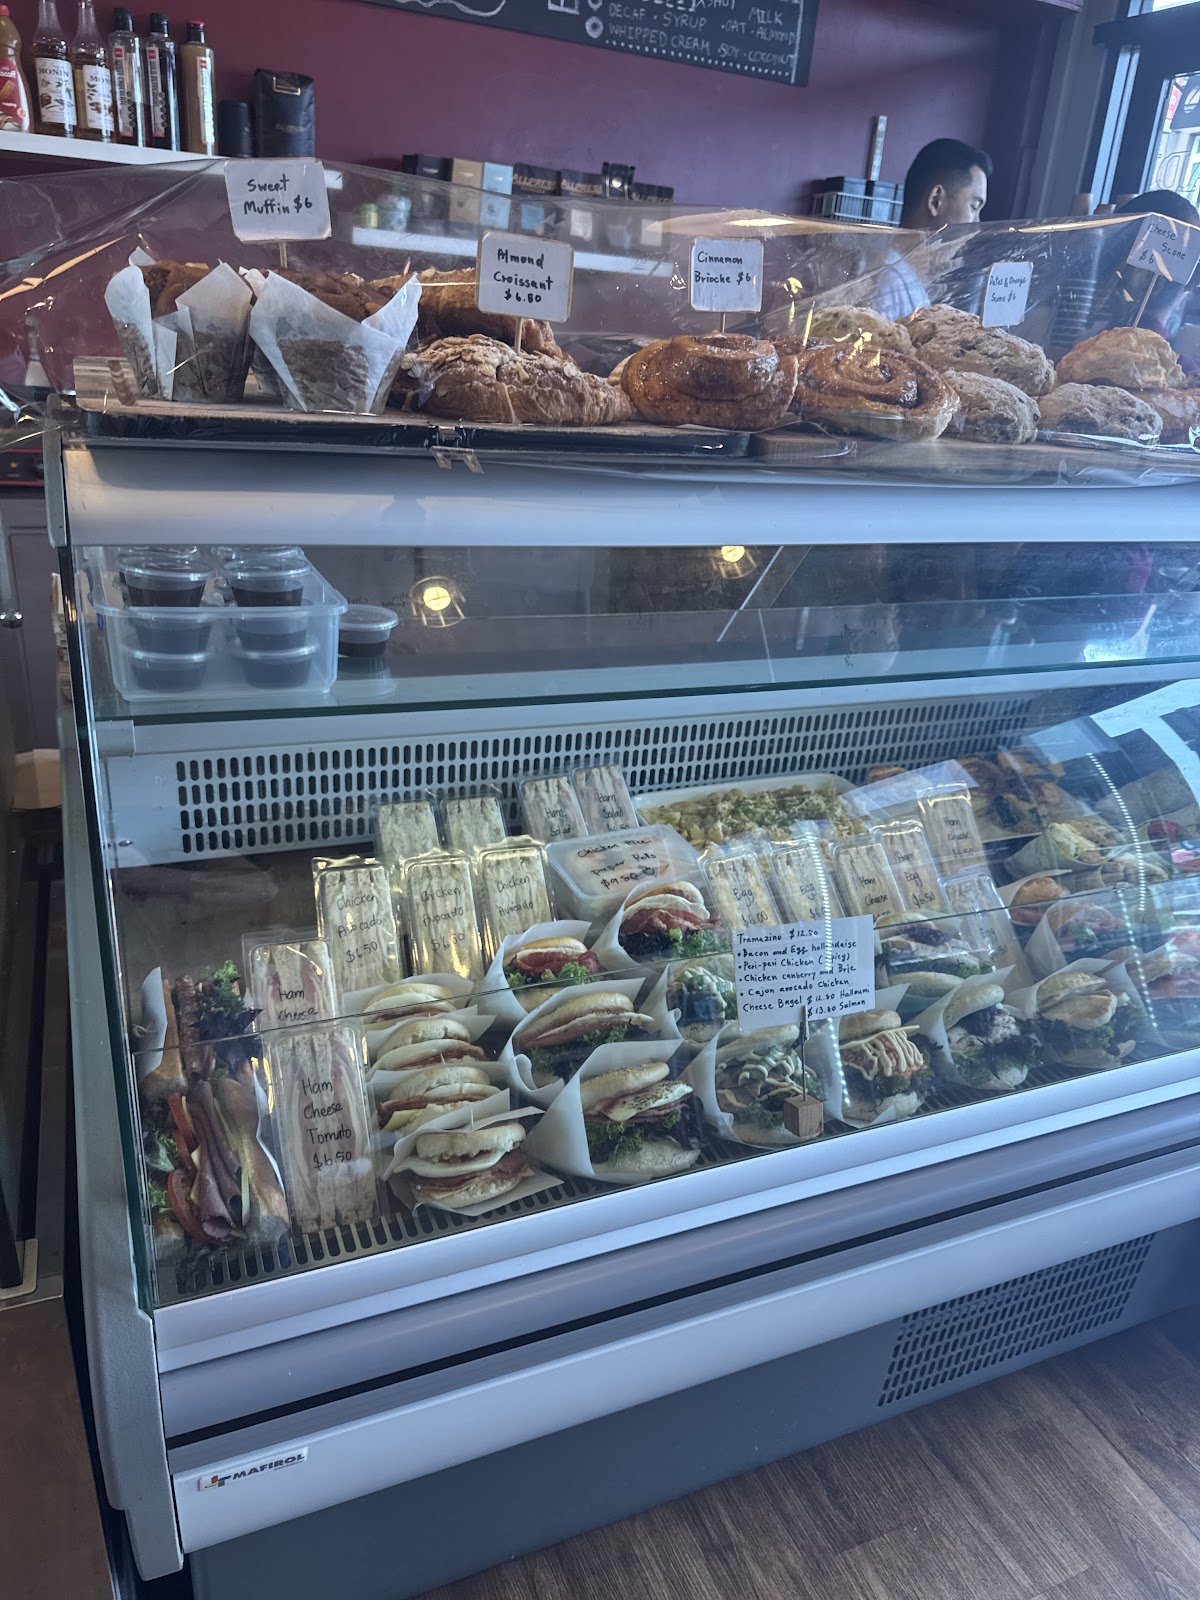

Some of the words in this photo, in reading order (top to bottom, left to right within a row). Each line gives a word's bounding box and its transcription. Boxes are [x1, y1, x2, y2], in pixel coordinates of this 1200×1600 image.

[609, 3, 645, 20] DECAF
[663, 12, 707, 31] SYRUP
[750, 7, 783, 25] MILK
[725, 19, 746, 34] OAT
[609, 22, 667, 47] WHIPPED
[671, 35, 710, 56] CREAM
[38, 67, 69, 78] MONIN
[247, 173, 289, 192] Sweet
[513, 173, 556, 191] ALLPRESS
[561, 178, 604, 195] ALLPRESS
[243, 198, 290, 215] Muffin
[293, 194, 313, 213] $6
[1149, 222, 1176, 241] Cheese
[497, 248, 545, 269] Almond
[697, 251, 743, 265] Cinnamon
[1161, 242, 1186, 260] Scone
[493, 270, 554, 291] Croissant
[694, 270, 731, 284] Brioche
[736, 271, 752, 286] $6
[596, 791, 617, 803] Ham
[497, 875, 530, 893] Chicken
[904, 871, 923, 888] Egg
[420, 886, 462, 903] Chicken
[800, 883, 817, 901] Egg
[337, 893, 378, 912] Chicken
[338, 917, 383, 939] Avocado
[741, 911, 769, 928] $6.00
[430, 932, 466, 953] $650
[737, 933, 782, 945] Tramazino
[743, 948, 769, 958] Bacon
[772, 945, 788, 955] and
[790, 944, 808, 955] Egg
[743, 957, 777, 971] Peri-peri
[780, 957, 814, 967] Chicken
[744, 972, 778, 982] Chicken
[820, 966, 834, 976] and
[838, 963, 857, 974] Brie
[279, 988, 305, 1002] Ham
[748, 985, 775, 998] Cajun
[780, 980, 814, 993] avocado
[742, 1002, 774, 1013] Cheese
[777, 995, 802, 1009] Bagel
[840, 985, 870, 1000] Halloumi
[839, 999, 866, 1011] Salmon
[302, 1078, 334, 1095] Ham
[304, 1101, 344, 1120] Cheese
[306, 1126, 352, 1145] Tomato
[313, 1151, 353, 1172] $6.50
[232, 1454, 305, 1480] MAFIROL
